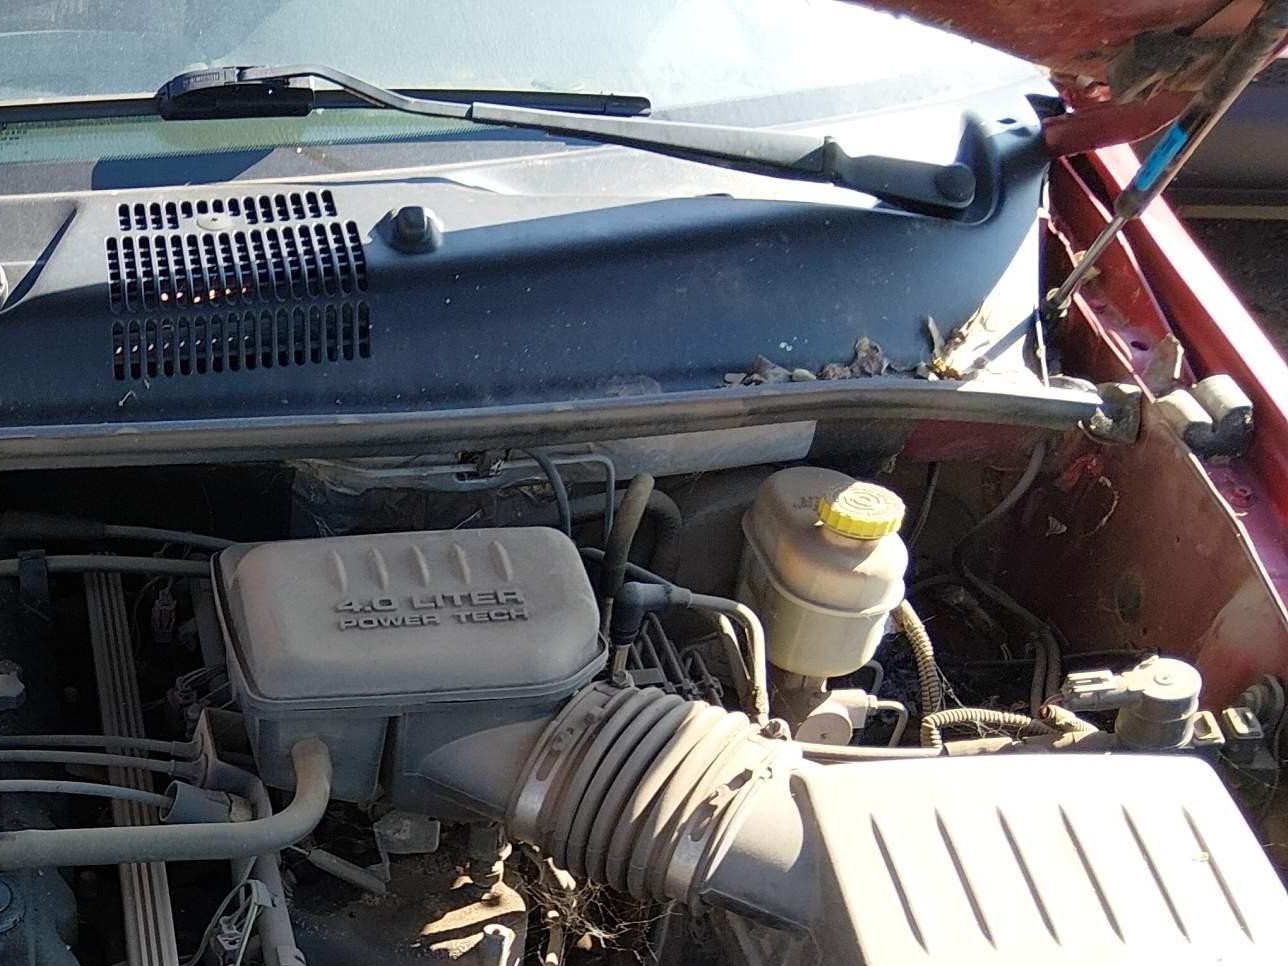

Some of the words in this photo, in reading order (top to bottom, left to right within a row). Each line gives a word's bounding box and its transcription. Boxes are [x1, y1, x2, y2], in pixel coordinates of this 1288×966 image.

[336, 596, 399, 613] 4.0
[411, 589, 526, 609] LITER
[338, 615, 440, 631] POWER
[455, 608, 528, 625] TECH
